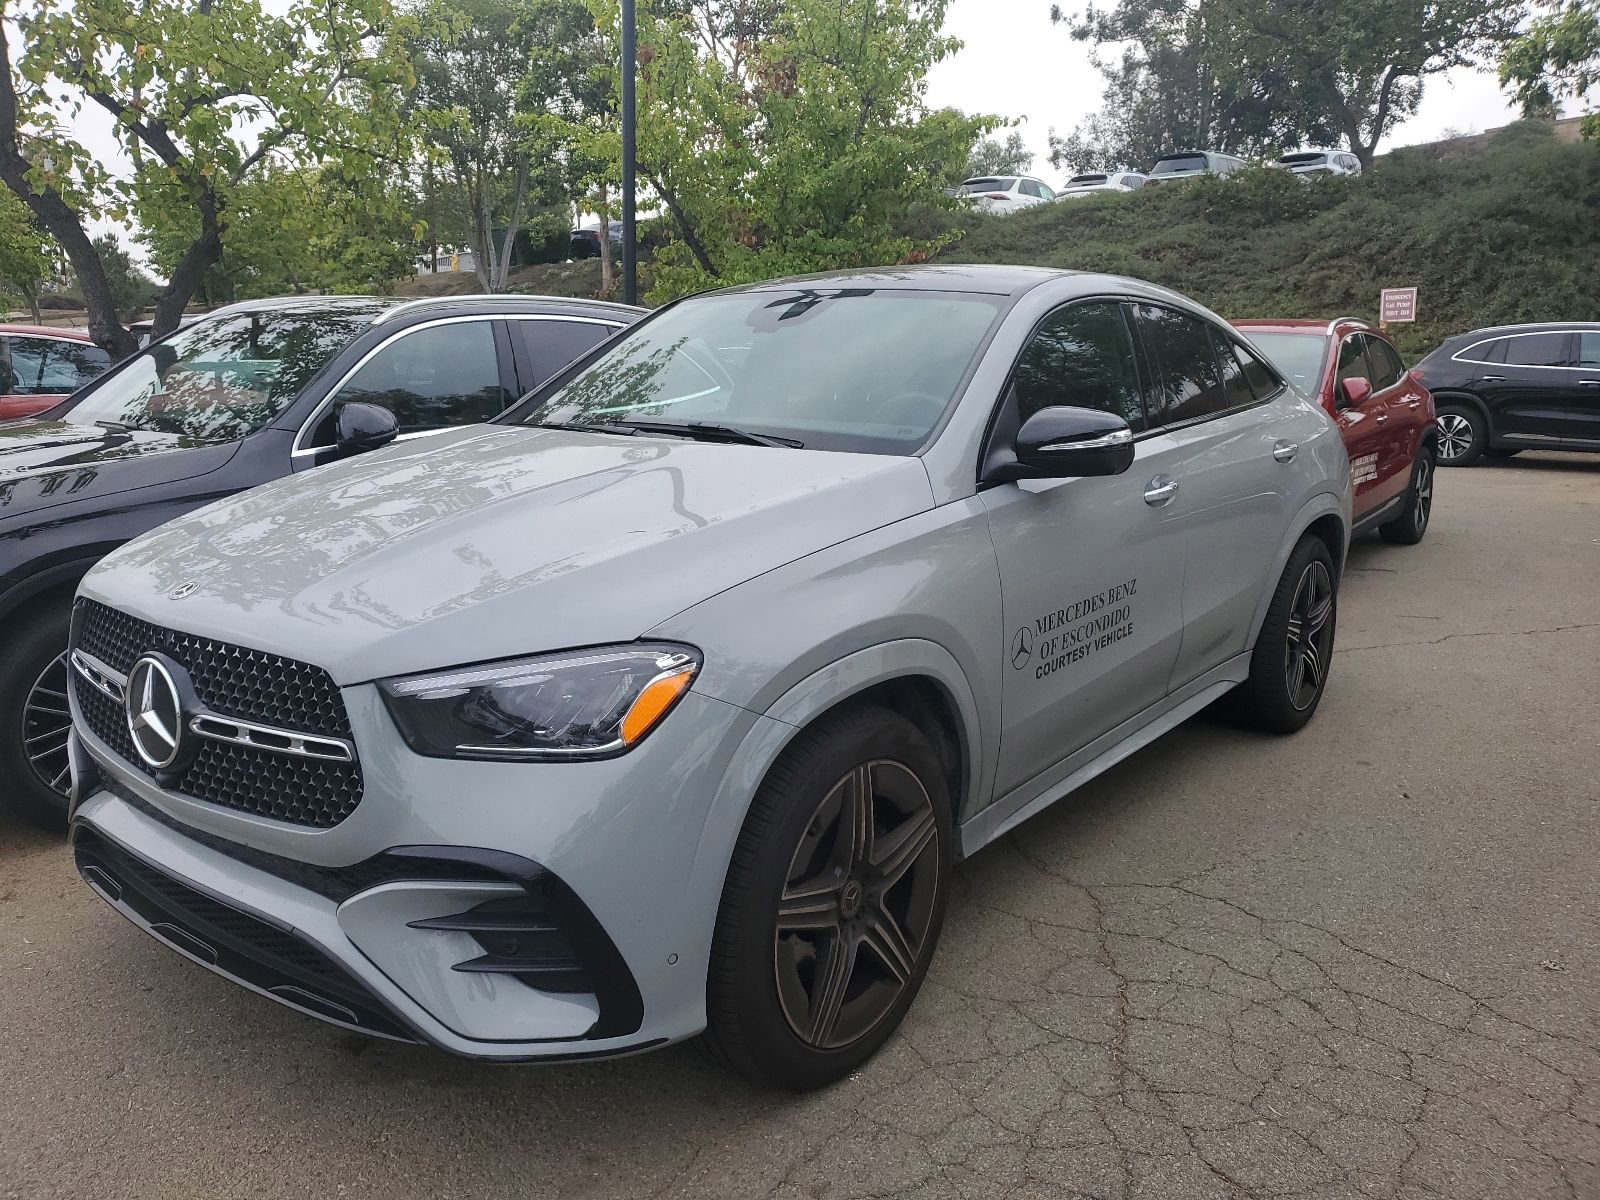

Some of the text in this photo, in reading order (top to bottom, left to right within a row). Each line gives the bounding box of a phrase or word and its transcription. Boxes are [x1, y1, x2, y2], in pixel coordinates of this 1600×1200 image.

[1033, 578, 1137, 637] MERCEDES BENZ
[1040, 604, 1130, 660] OF ESCONDIDO
[1035, 622, 1133, 680] COURTESY VEHICLE
